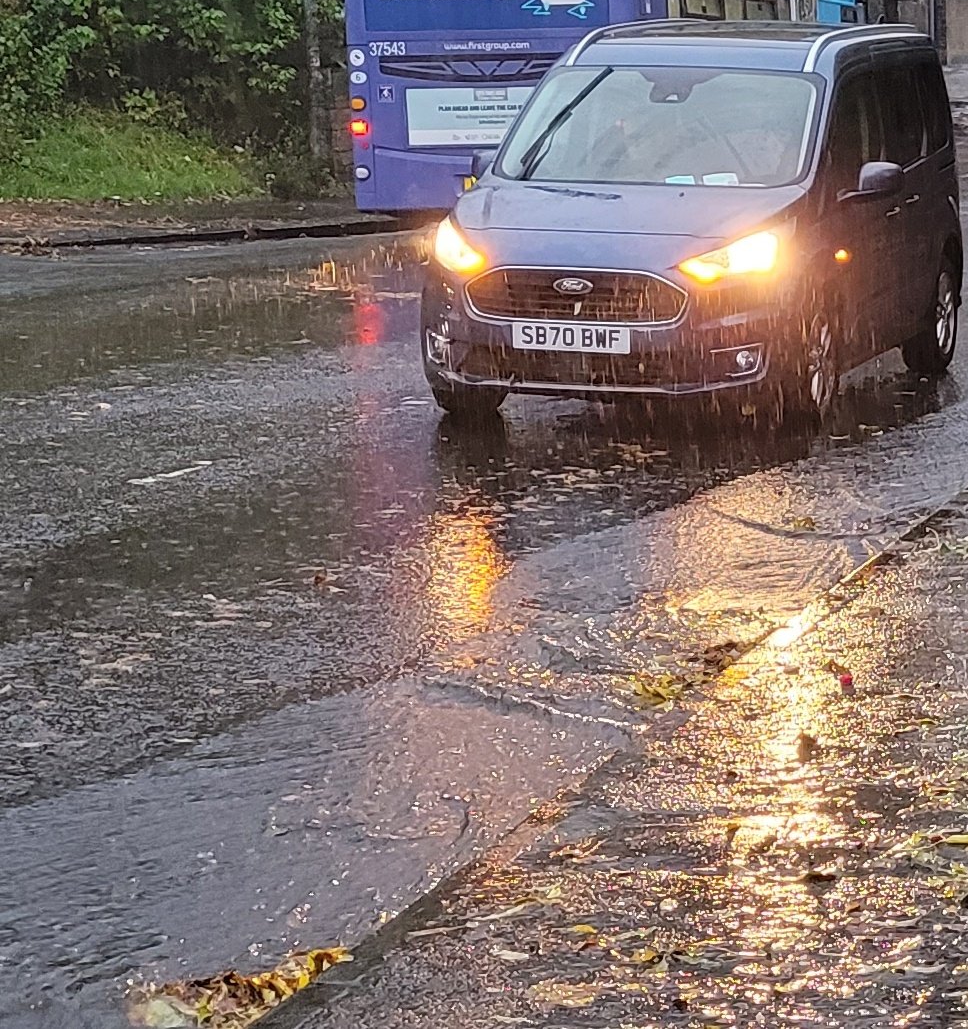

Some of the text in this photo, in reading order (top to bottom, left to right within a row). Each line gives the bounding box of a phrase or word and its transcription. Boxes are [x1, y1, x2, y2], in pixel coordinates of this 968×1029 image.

[369, 41, 406, 56] 37543
[443, 41, 530, 51] www.firstgroup.com
[561, 280, 584, 290] Ford
[521, 325, 621, 349] SB70 BWF
